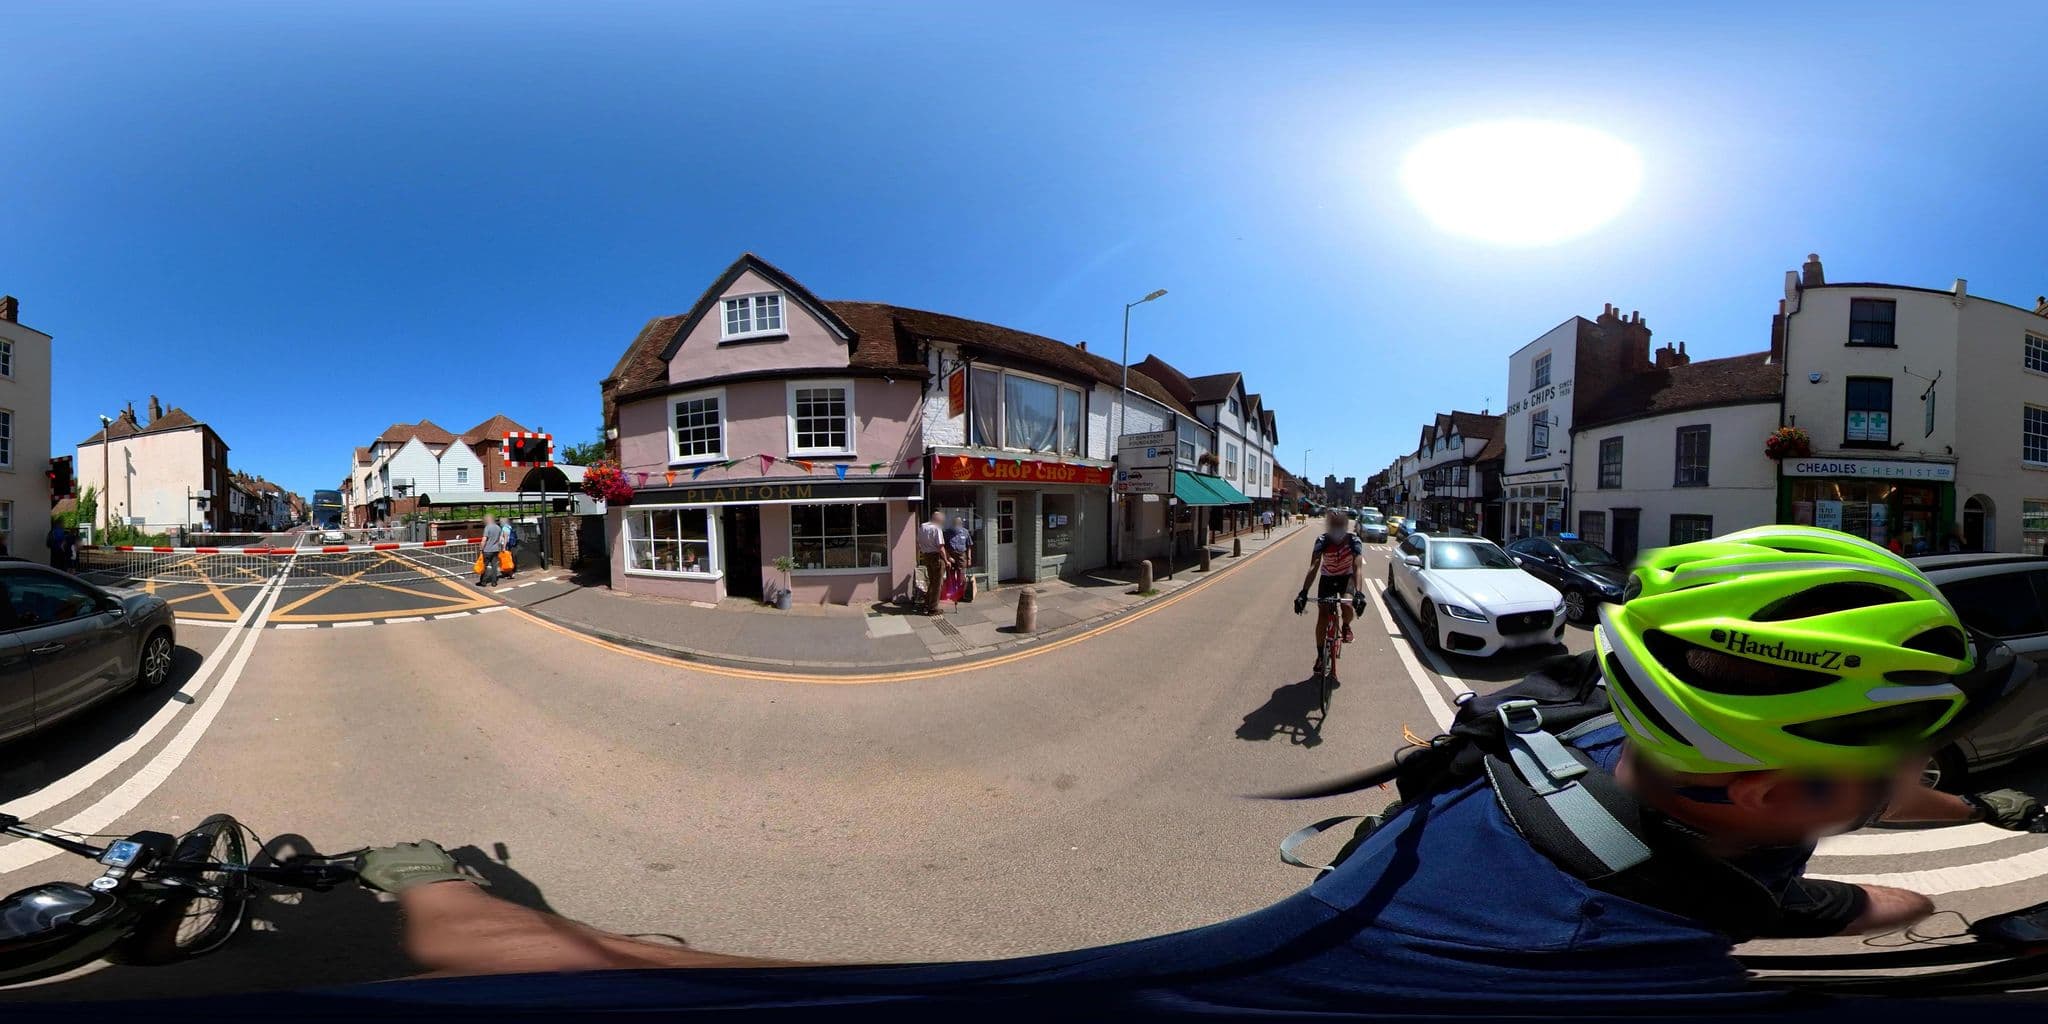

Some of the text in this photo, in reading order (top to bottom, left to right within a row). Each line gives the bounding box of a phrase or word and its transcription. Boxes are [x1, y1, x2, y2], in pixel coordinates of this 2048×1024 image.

[1559, 379, 1573, 389] SINCE
[1508, 386, 1556, 417] FISH & CHIPS
[982, 463, 1032, 479] CHOP
[1036, 465, 1077, 481] CHOP
[1796, 463, 1857, 474] CHEADLES
[1860, 466, 1932, 477] CHEMIST
[687, 485, 812, 501] PLATFORM
[1726, 630, 1842, 670] HardnutZ
